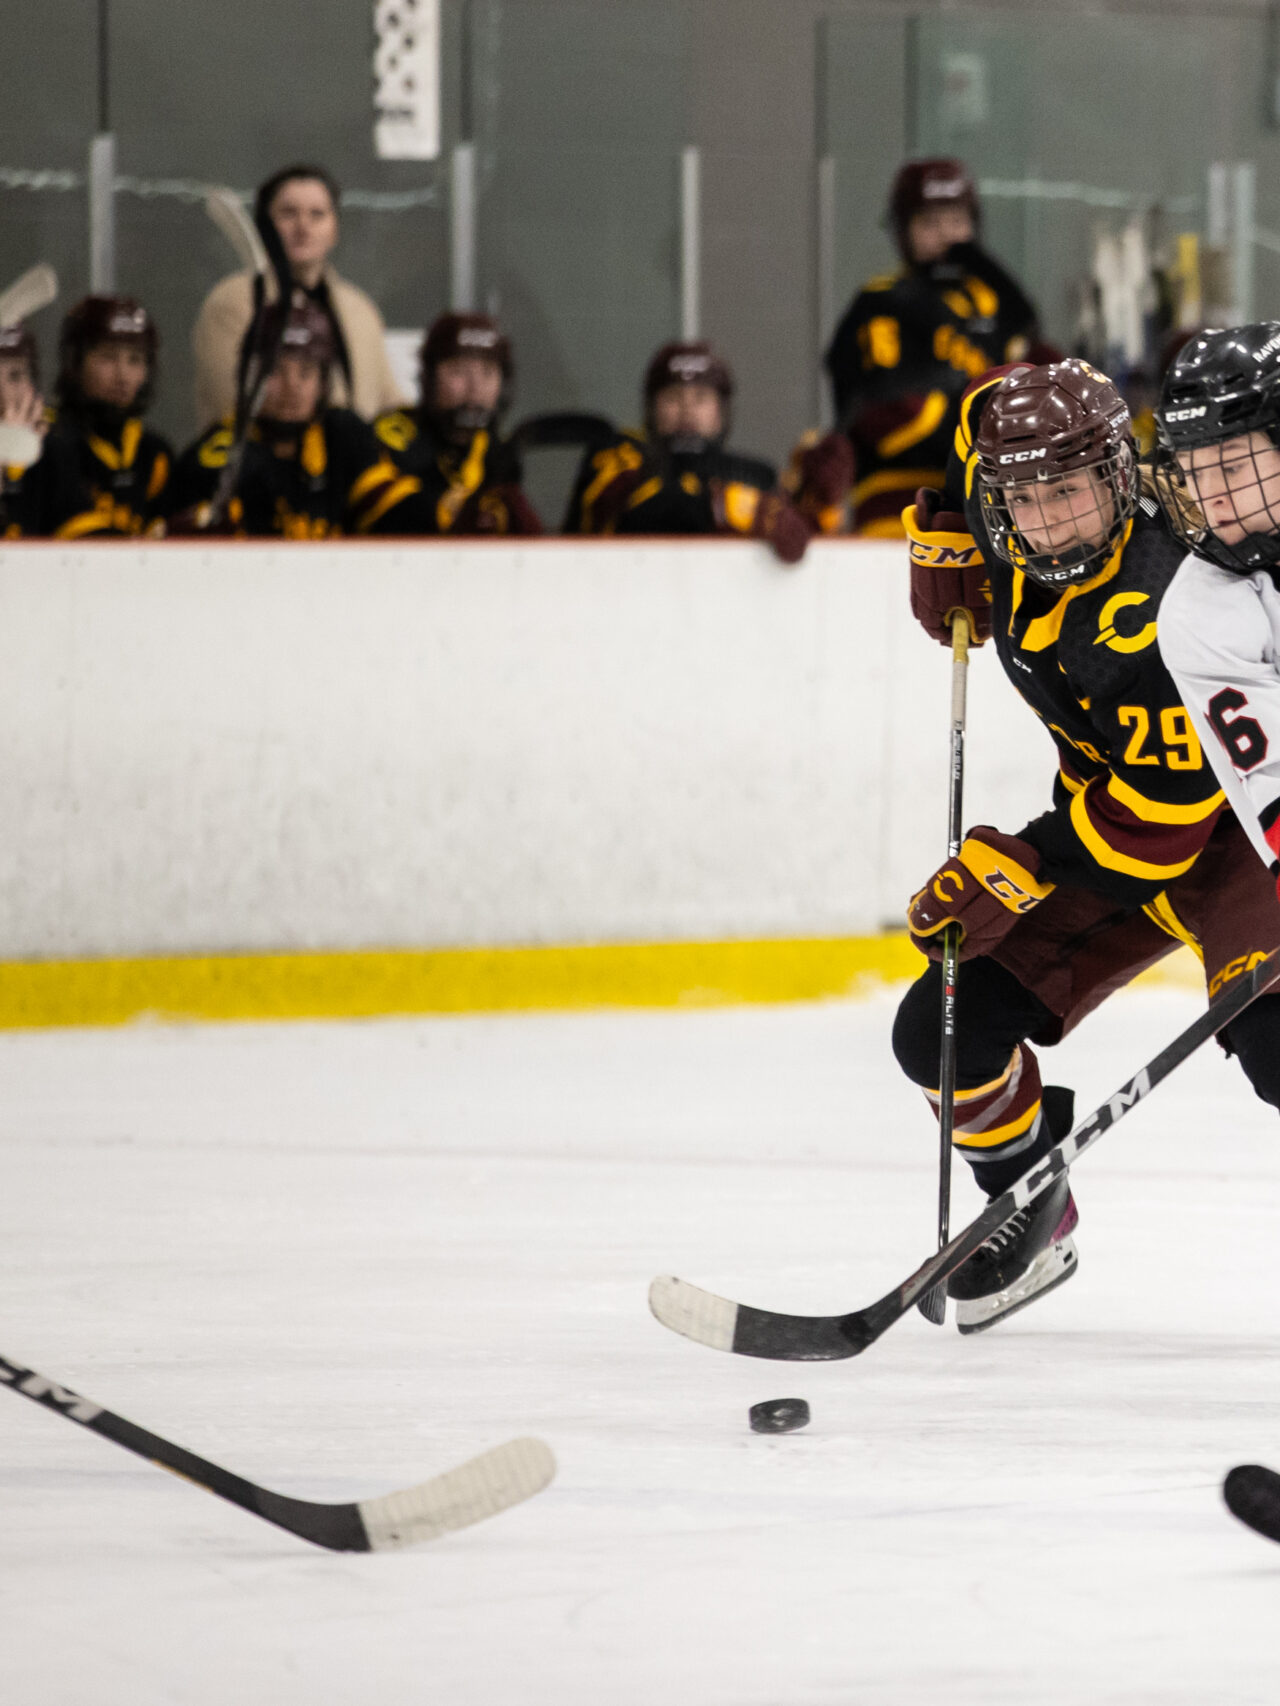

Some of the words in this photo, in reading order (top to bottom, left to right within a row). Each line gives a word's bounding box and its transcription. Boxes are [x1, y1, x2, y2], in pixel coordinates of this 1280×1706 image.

[1165, 406, 1207, 423] CCM
[1000, 447, 1047, 465] CCM
[1117, 705, 1203, 771] 29
[1010, 1066, 1152, 1212] CCM
